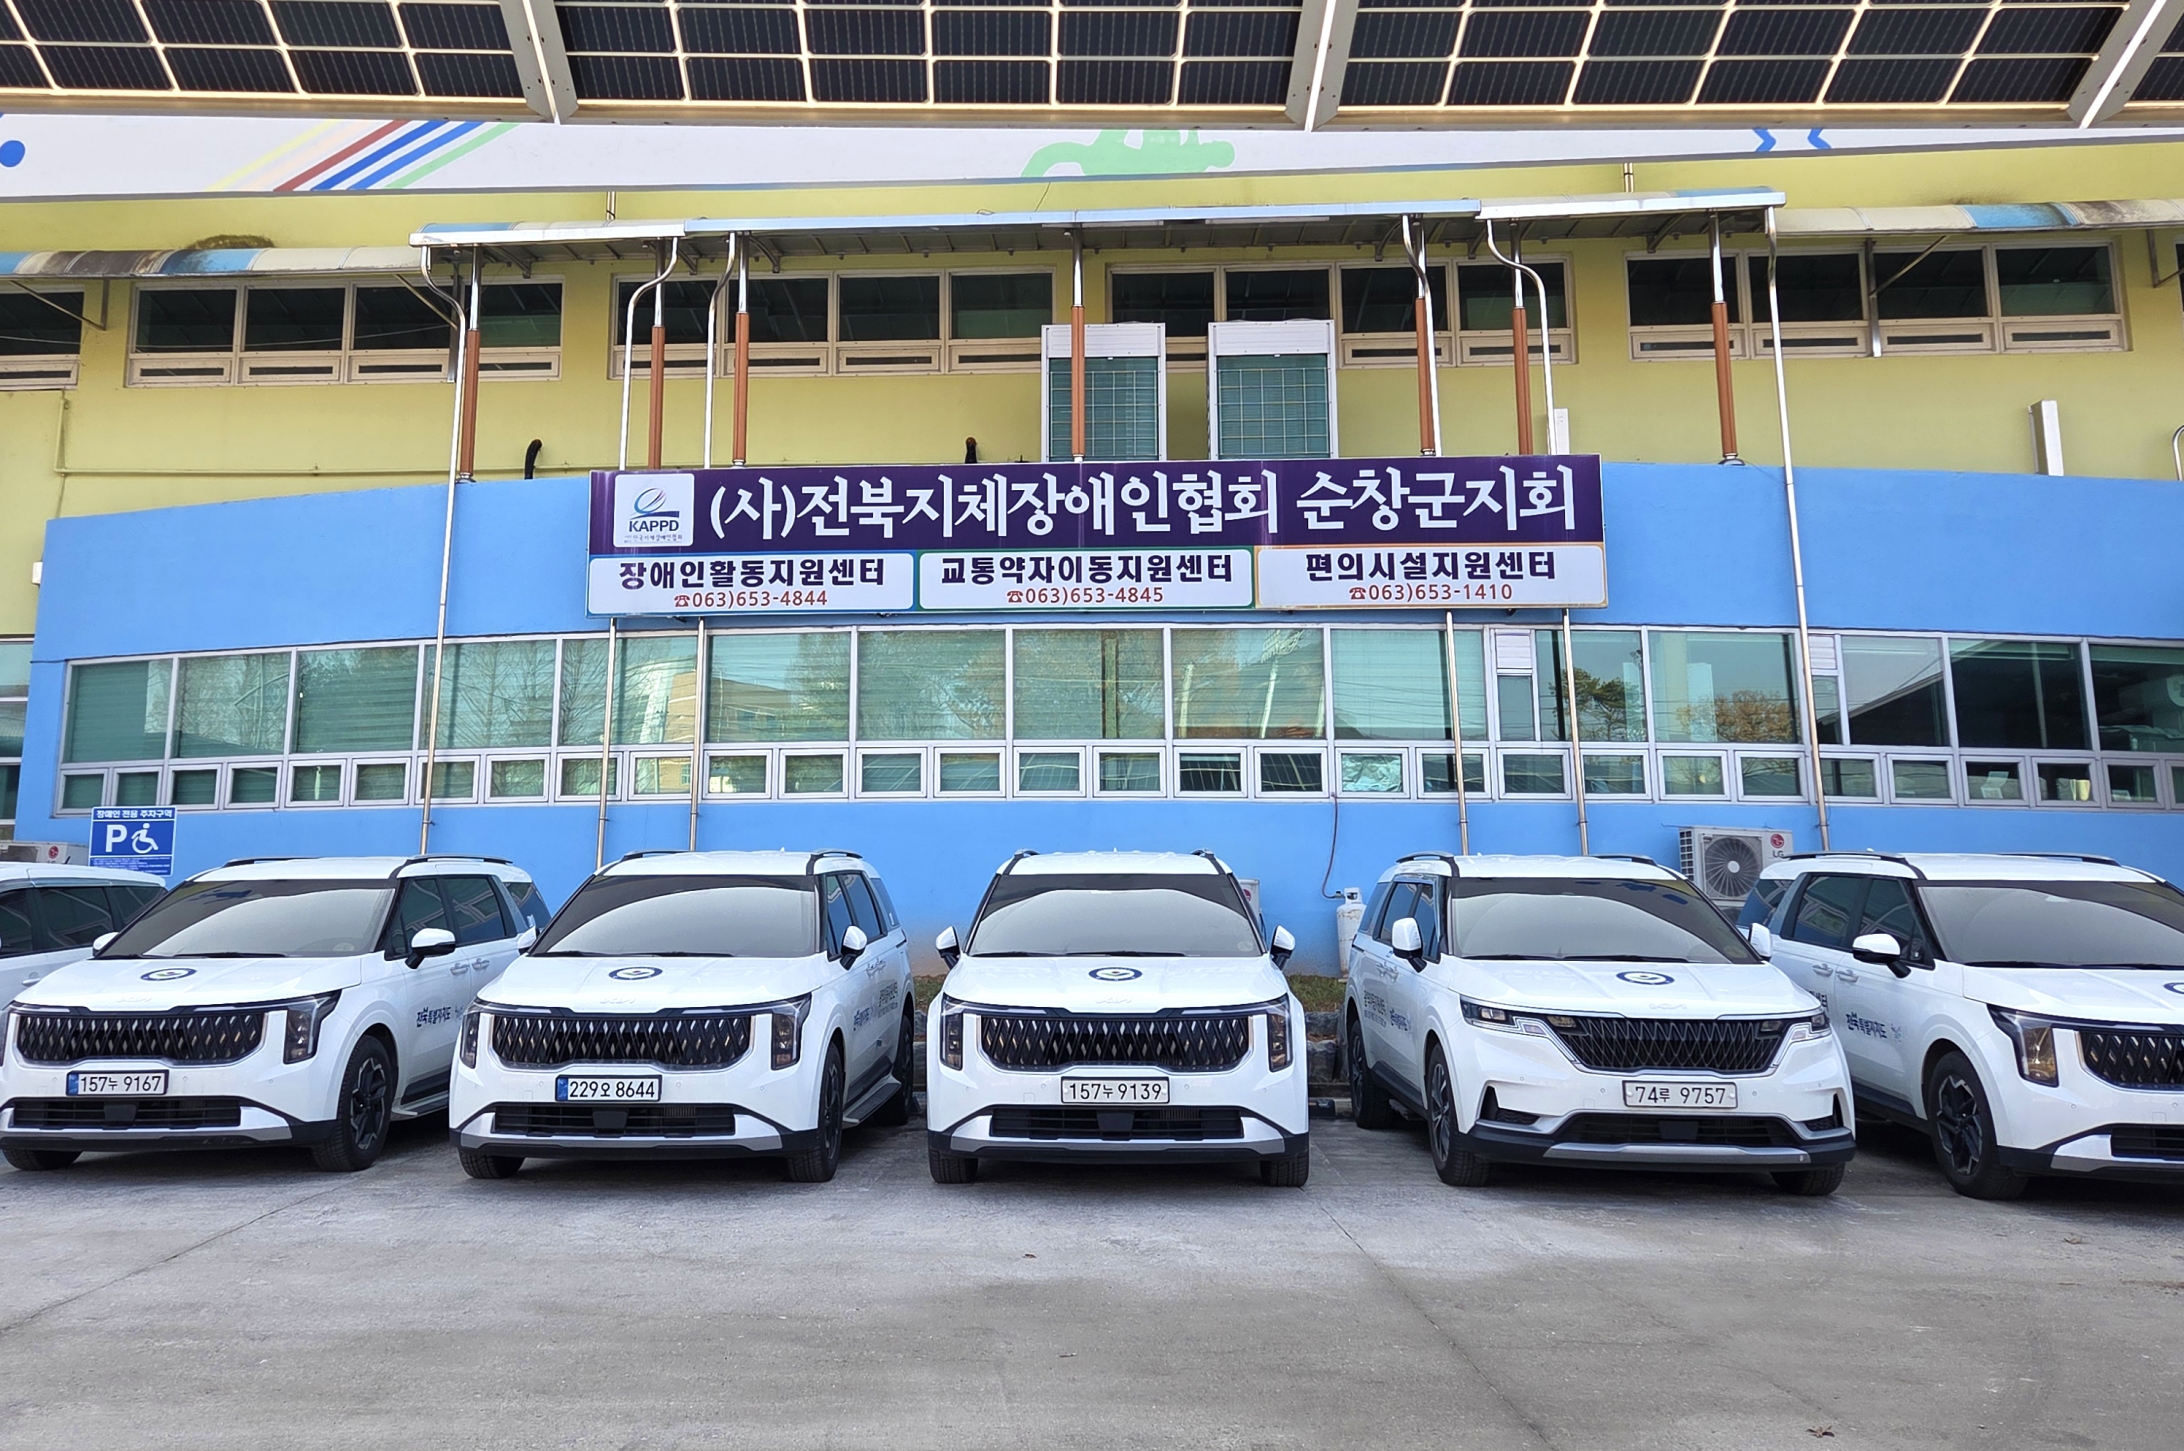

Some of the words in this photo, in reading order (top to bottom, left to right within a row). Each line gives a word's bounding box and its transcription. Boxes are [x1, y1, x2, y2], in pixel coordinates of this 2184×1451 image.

[709, 468, 1279, 540] (사)전북지체장애인협회
[1296, 464, 1576, 532] 순창군지회
[628, 519, 680, 533] KAPPD
[618, 557, 886, 590] 장애인활동지원센터
[940, 553, 1233, 586] 교통약자이동지원센터
[1304, 550, 1557, 583] 편의시설지원센터
[96, 809, 121, 819] 장애인
[121, 809, 139, 819] 전용
[105, 824, 128, 853] P
[1772, 850, 1785, 858] LG
[80, 1076, 119, 1092] 157누
[123, 1075, 162, 1092] 9167
[569, 1080, 611, 1098] 229오
[615, 1081, 655, 1098] 8644
[1069, 1083, 1114, 1100] 157누
[1117, 1083, 1162, 1100] 9139
[1635, 1086, 1671, 1104] 74루
[1680, 1086, 1726, 1104] 9757
